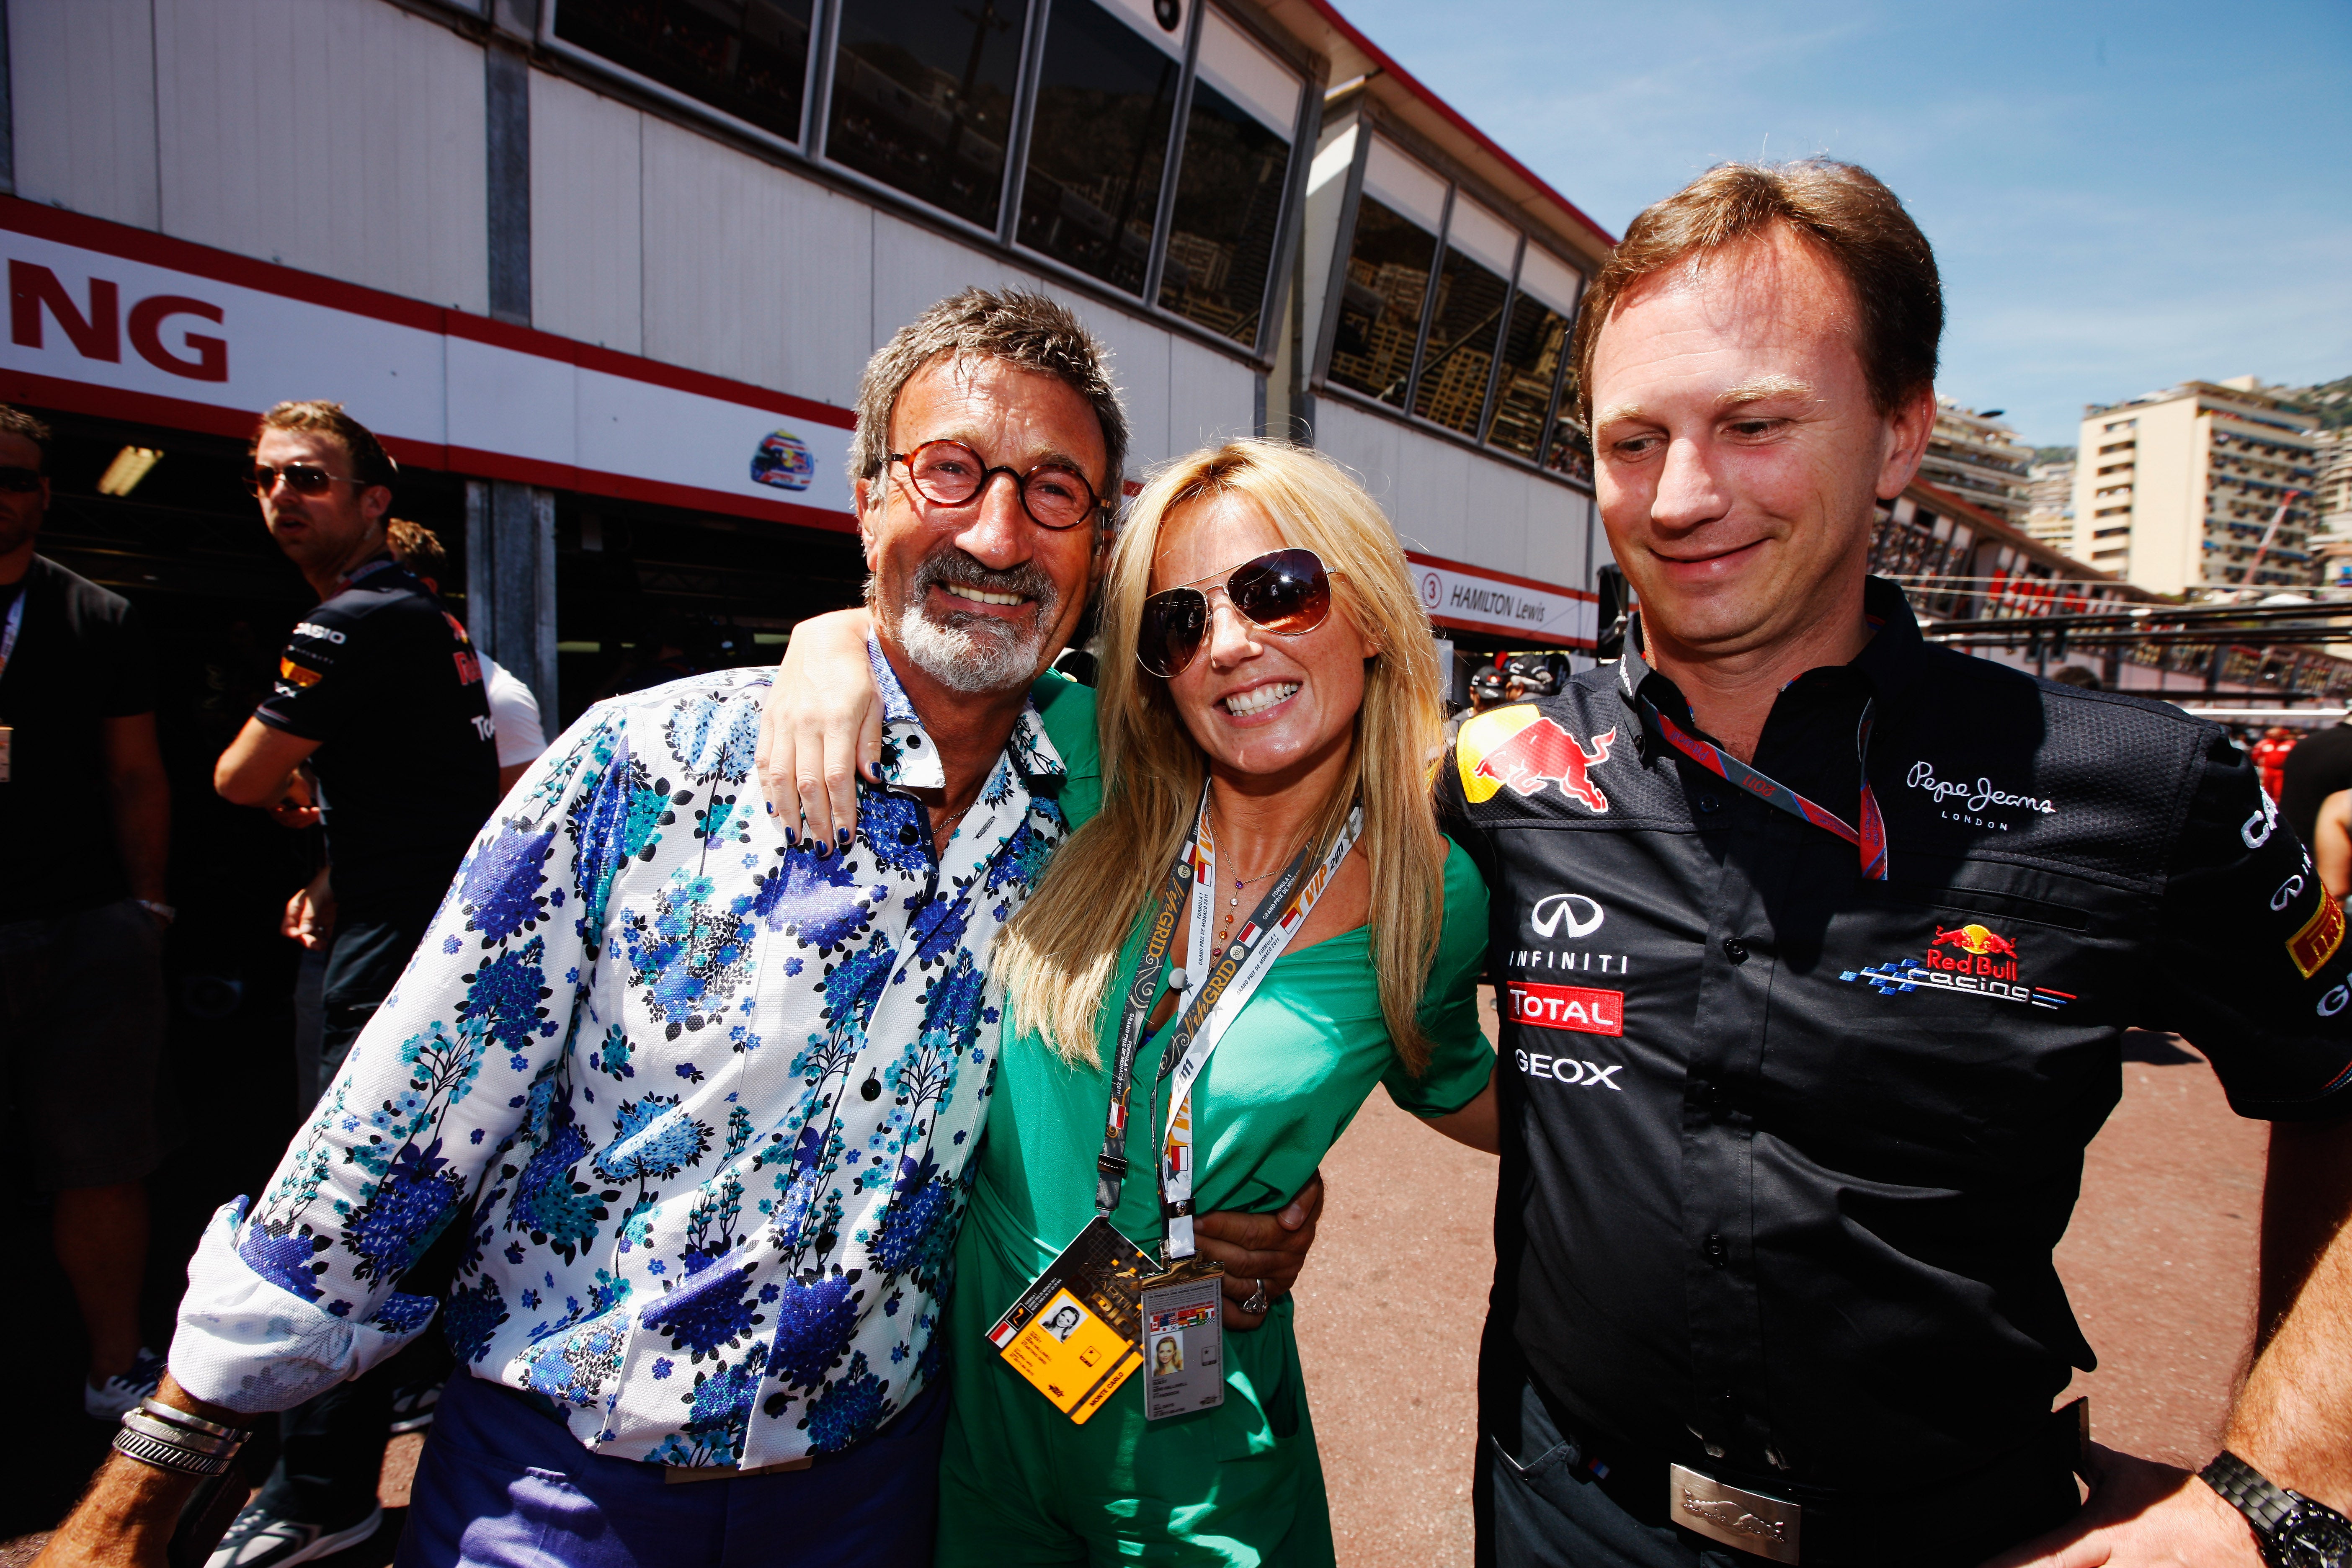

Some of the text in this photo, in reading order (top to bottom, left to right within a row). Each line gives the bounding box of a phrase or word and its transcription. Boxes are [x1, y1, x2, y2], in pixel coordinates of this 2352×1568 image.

[9, 257, 229, 383] NG
[1428, 580, 1545, 622] 3 HAMILTON Lewis
[1669, 729, 1710, 761] Pitwall
[1741, 772, 1776, 799] 2011
[1908, 761, 2056, 813] Pepe Jeans
[1942, 811, 2008, 830] LONDON
[1329, 841, 1344, 870] 2011
[1271, 877, 1289, 898] FORMULA
[1262, 903, 1277, 921] GRAND
[1273, 893, 1284, 905] PRIX
[1232, 945, 1244, 959] 2011
[1258, 936, 1274, 956] FORMULA
[1236, 979, 1250, 995] GRAND
[1246, 970, 1256, 981] PRIX
[1258, 946, 1273, 965] MONACO
[1270, 937, 1280, 948] 2011
[1509, 951, 1627, 973] INFINITI
[1927, 949, 2017, 981] Red Bull
[1908, 969, 2030, 1002] racing
[1510, 990, 1614, 1025] TOTAL
[1124, 1012, 1134, 1034] GRAND
[1117, 1056, 1126, 1080] MONACO
[1123, 1040, 1132, 1067] FORMULA
[1515, 1049, 1623, 1090] GEOX
[1089, 1371, 1124, 1407] MONTE CARLO
